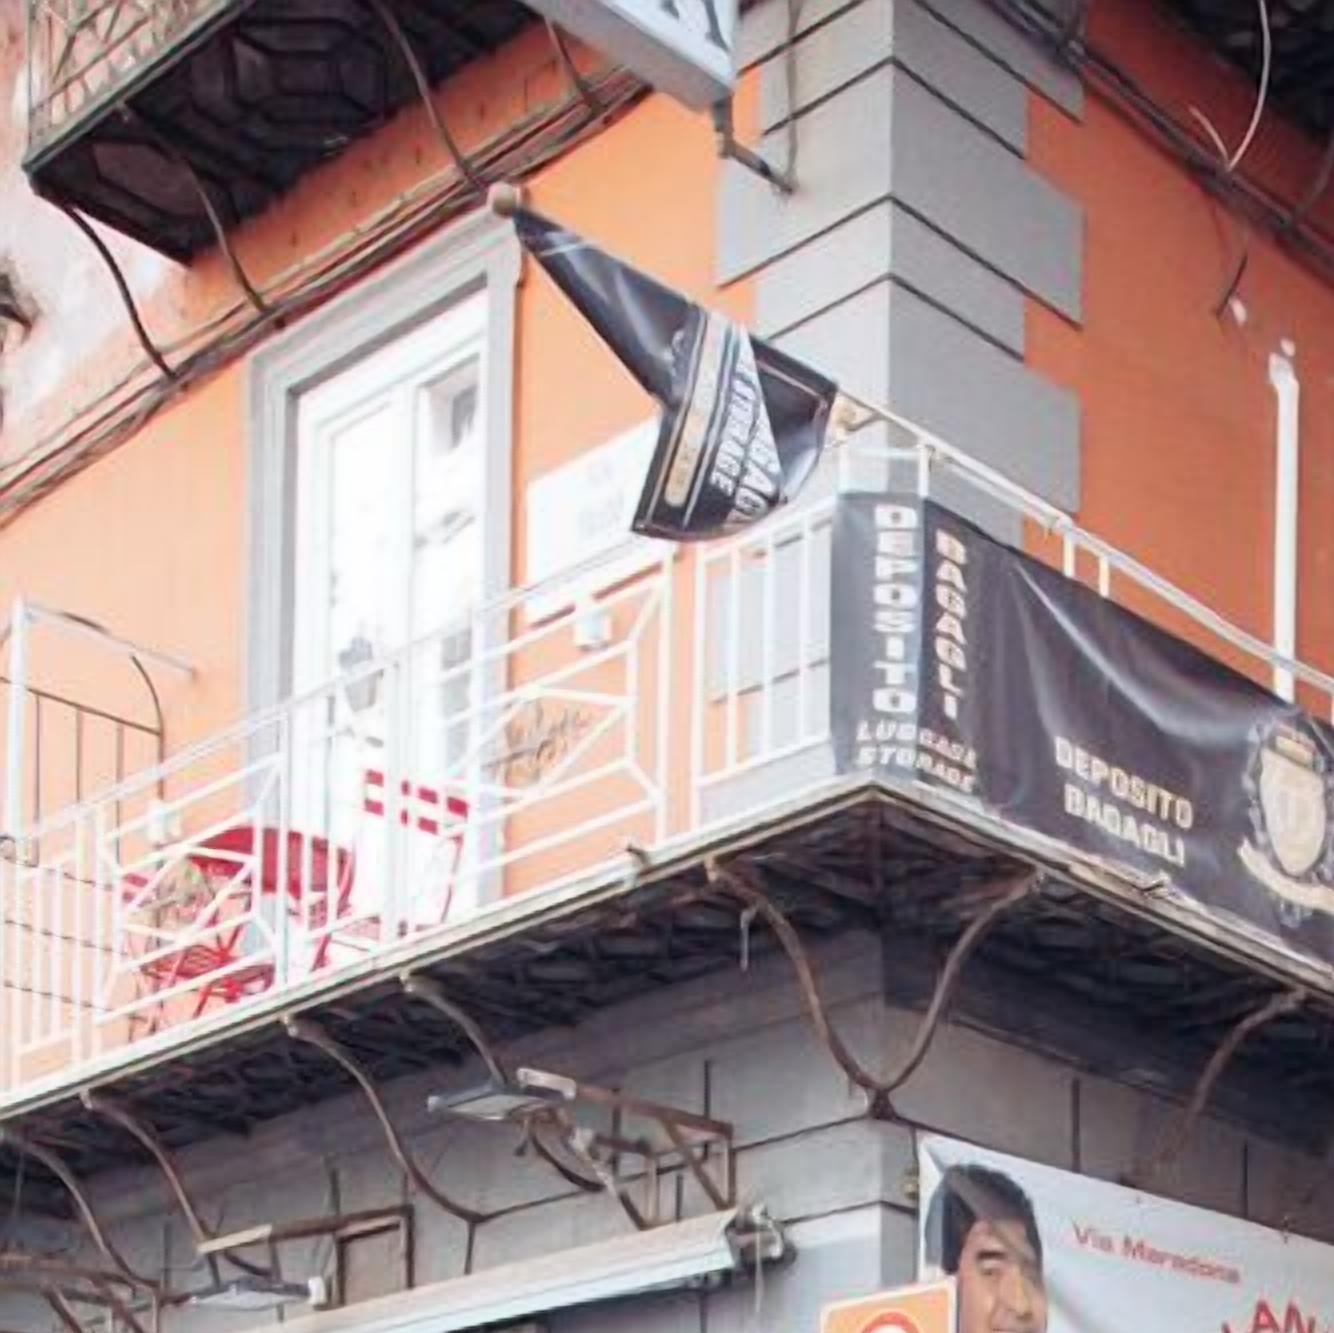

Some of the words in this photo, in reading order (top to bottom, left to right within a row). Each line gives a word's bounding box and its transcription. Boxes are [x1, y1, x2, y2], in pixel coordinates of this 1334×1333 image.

[873, 504, 918, 713] DEPOSITO
[935, 528, 967, 719] BAGAGLI
[856, 745, 976, 792] STORAGE
[1055, 735, 1193, 830] DEPOSITO
[1064, 783, 1184, 867] BAGAGLI
[1072, 1219, 1113, 1251] Via
[1121, 1235, 1241, 1284] Maradona
